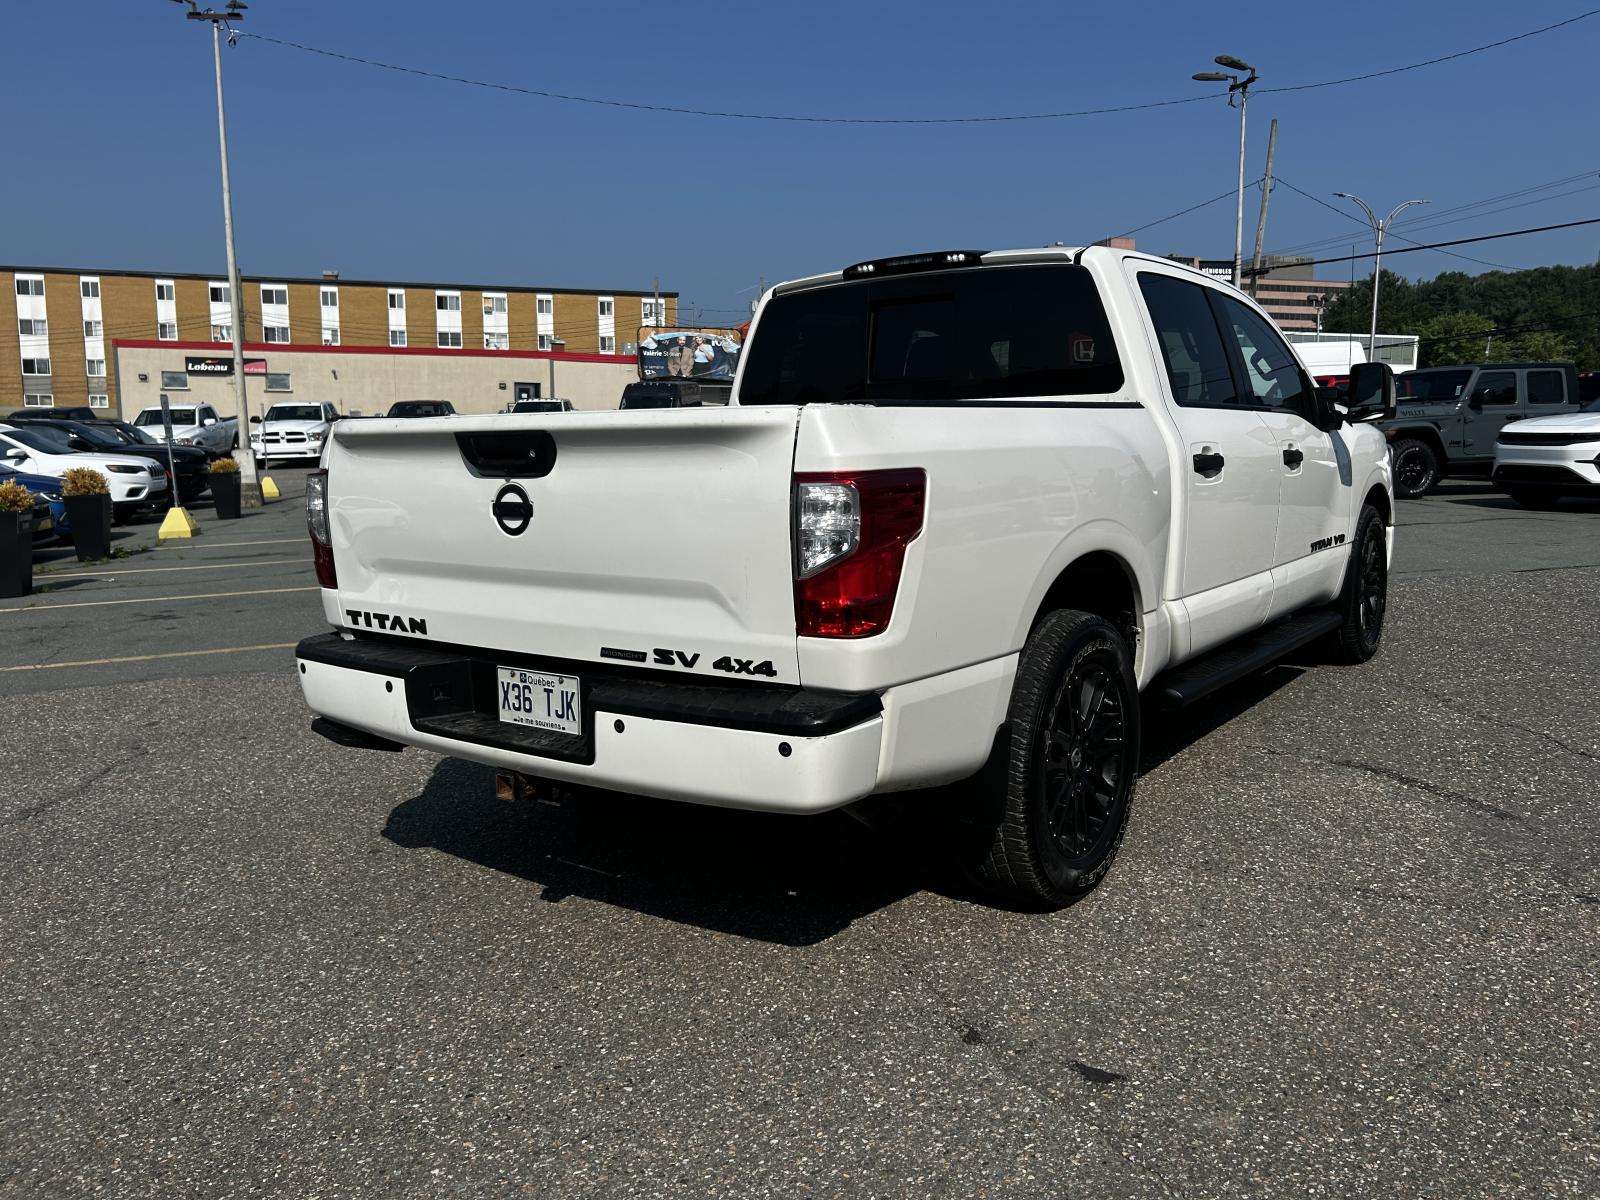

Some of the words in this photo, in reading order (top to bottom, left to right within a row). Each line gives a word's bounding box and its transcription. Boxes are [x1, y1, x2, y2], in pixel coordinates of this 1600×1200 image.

[346, 609, 428, 636] TITAN
[653, 648, 700, 669] SV
[527, 675, 555, 688] Québec
[501, 680, 532, 713] X36
[544, 687, 576, 721] TJK
